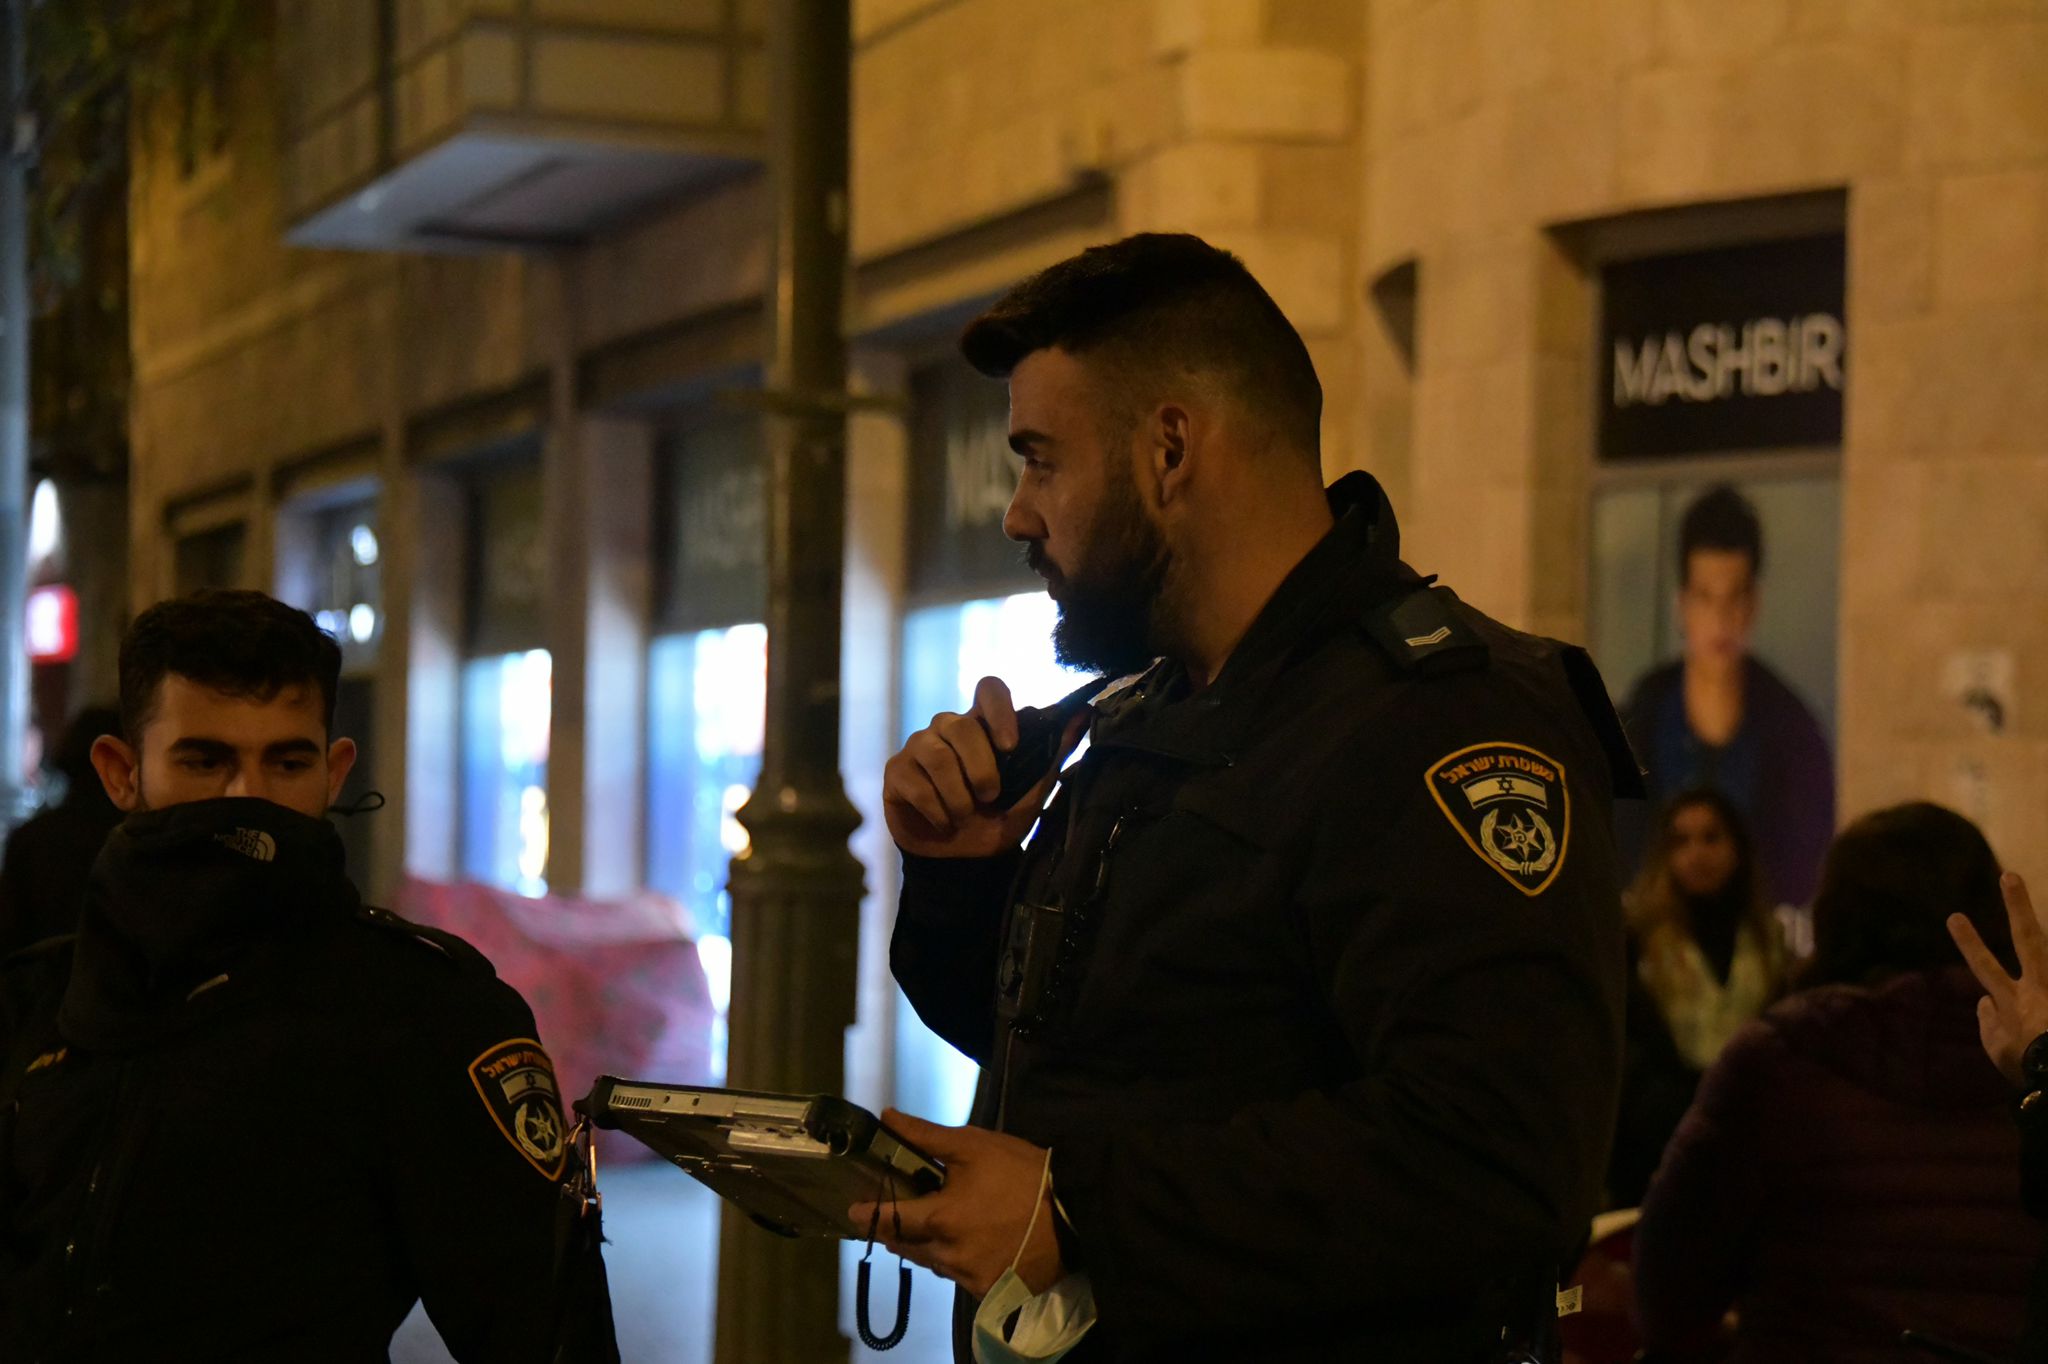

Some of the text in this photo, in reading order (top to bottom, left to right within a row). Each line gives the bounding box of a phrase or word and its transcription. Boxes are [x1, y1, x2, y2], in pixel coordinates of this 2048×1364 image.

[1613, 313, 1843, 405] MASHBIR
[1439, 754, 1556, 785] משטרת ישראל
